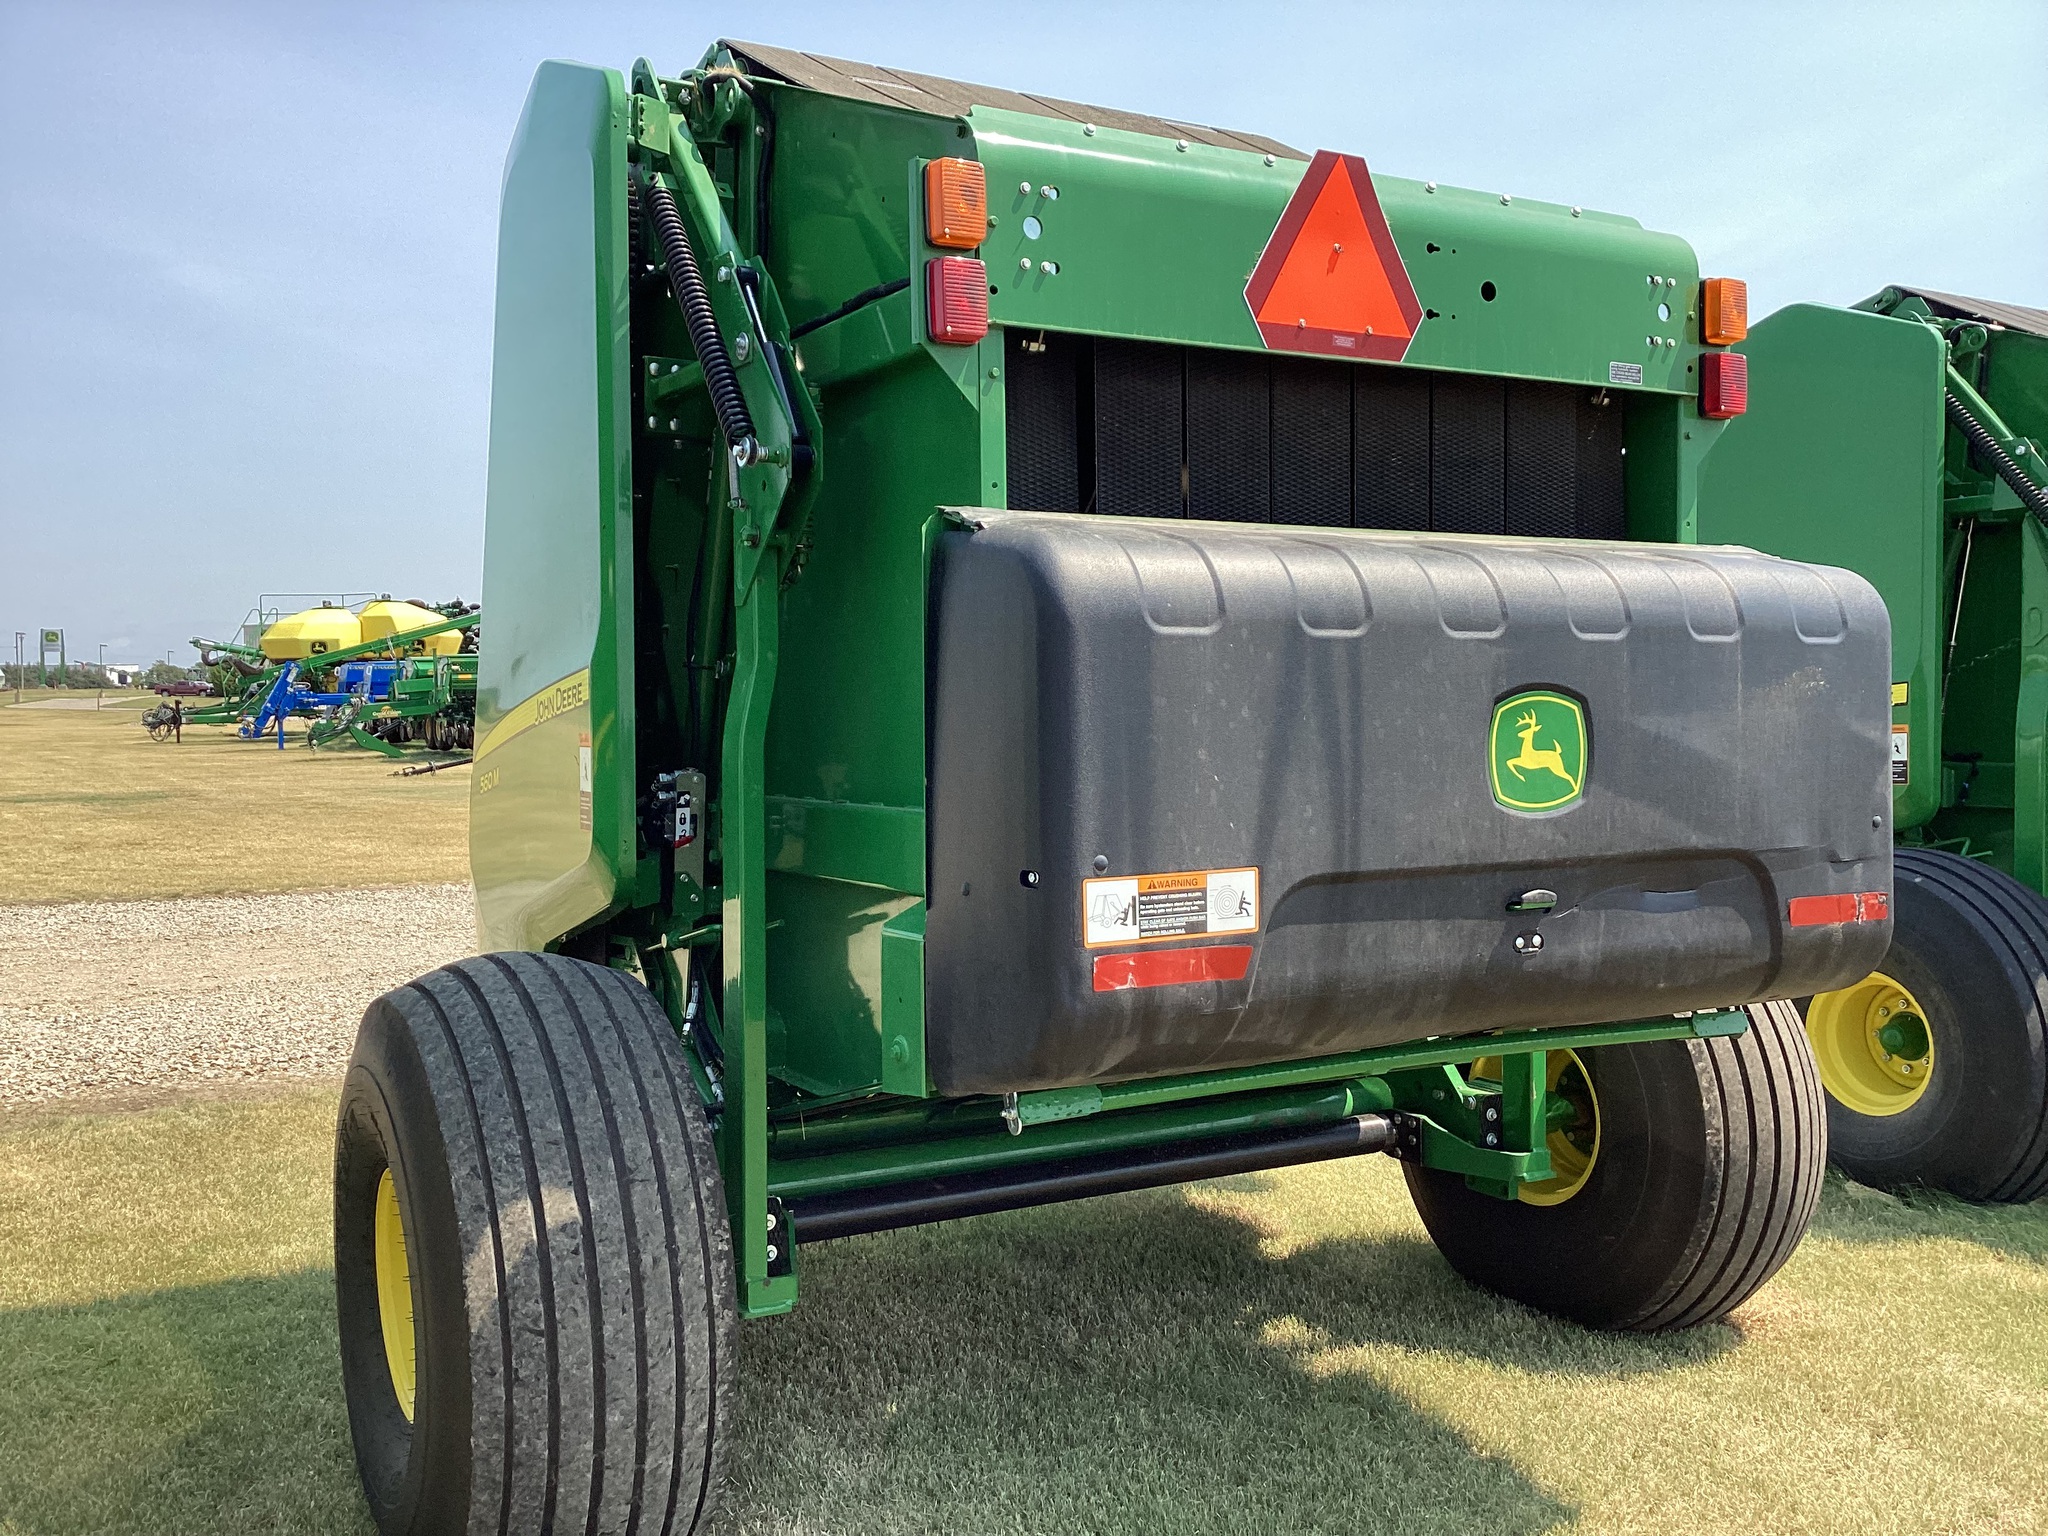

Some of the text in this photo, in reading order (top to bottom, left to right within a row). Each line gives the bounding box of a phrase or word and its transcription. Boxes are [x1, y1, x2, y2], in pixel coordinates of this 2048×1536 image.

[535, 682, 583, 722] JOHN DEERE
[1157, 878, 1198, 888] WARNING
